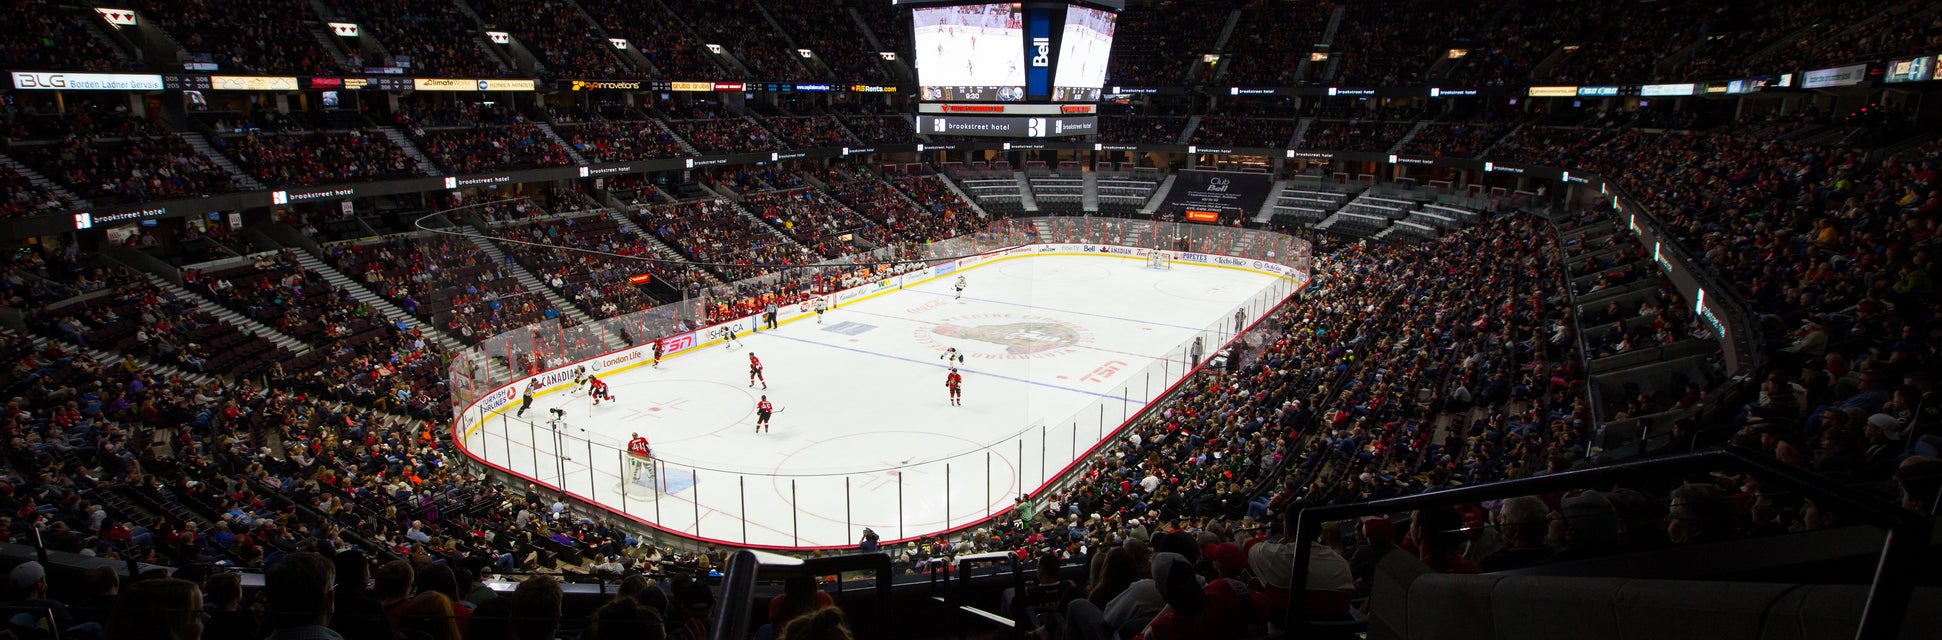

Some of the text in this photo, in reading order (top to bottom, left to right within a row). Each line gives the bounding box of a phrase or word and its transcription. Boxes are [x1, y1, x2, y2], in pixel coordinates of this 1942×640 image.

[1032, 37, 1050, 67] Bell
[18, 74, 159, 89] BLG Borden Ladner Gervais
[290, 190, 333, 200] brookstreet
[92, 208, 166, 224] brookstreet hotel
[603, 350, 642, 368] London Life
[542, 368, 579, 387] CANADIA
[482, 390, 506, 405] TURKISH
[483, 397, 507, 413] AIRLINES
